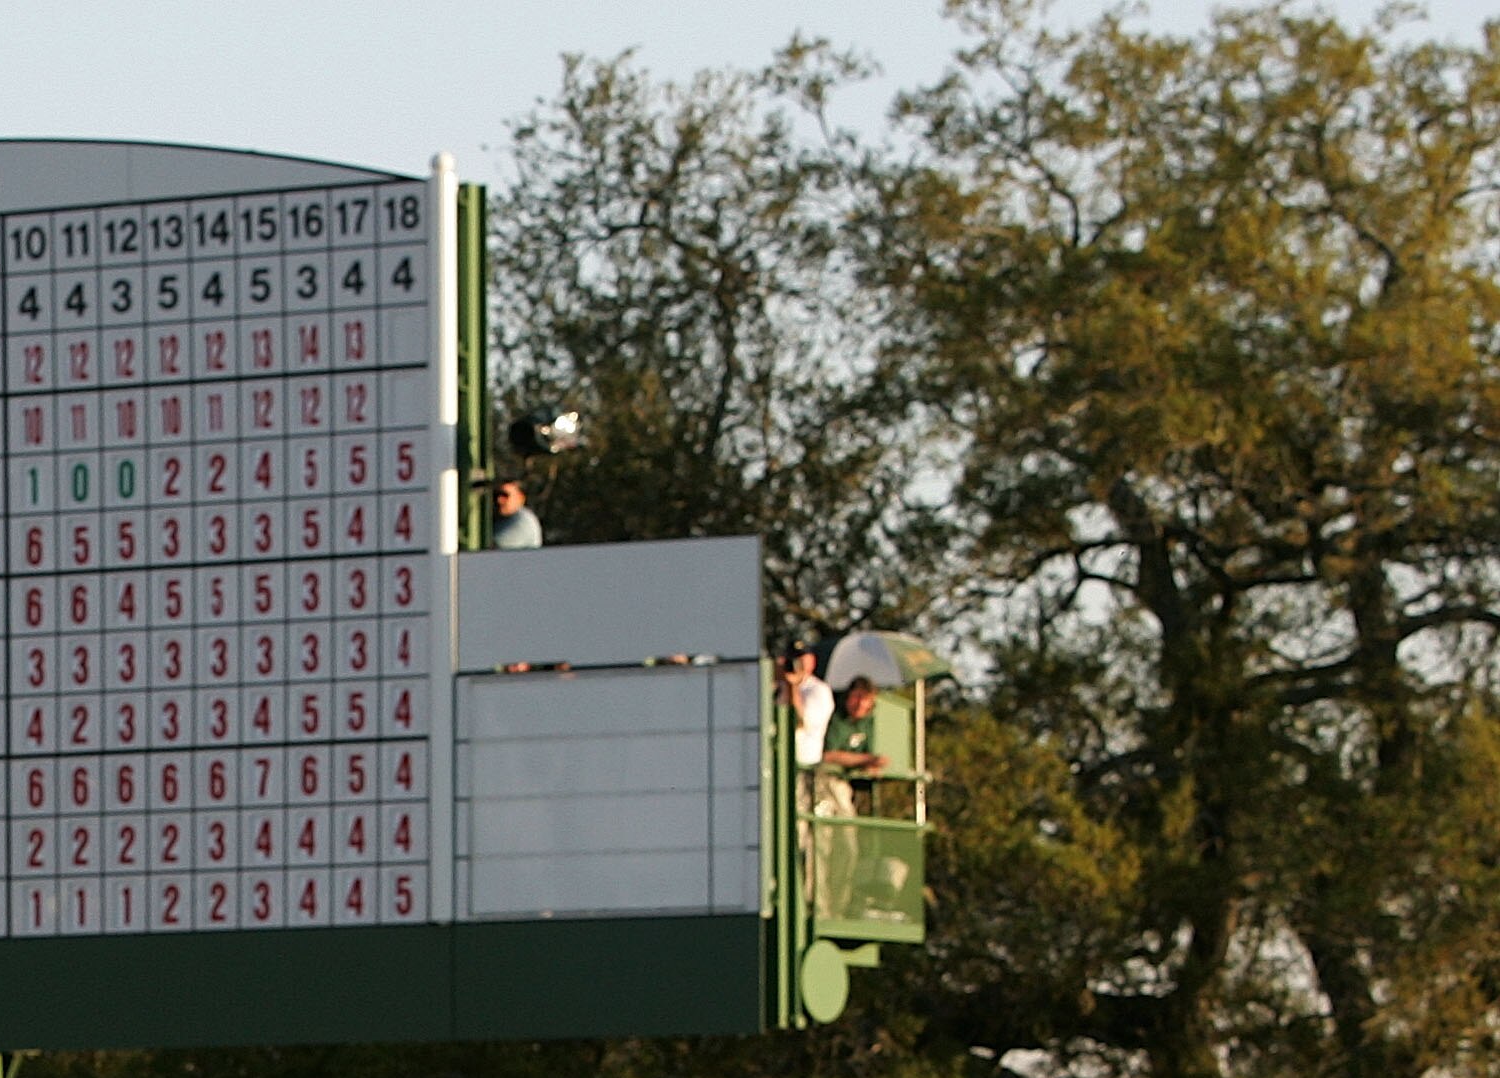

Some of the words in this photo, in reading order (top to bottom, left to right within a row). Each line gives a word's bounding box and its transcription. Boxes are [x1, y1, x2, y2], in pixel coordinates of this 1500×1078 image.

[12, 226, 47, 260] 10
[64, 224, 88, 256] 11
[106, 218, 138, 253] 12
[150, 215, 183, 249] 13
[196, 211, 230, 246] 14
[242, 206, 277, 242] 15
[290, 203, 323, 238] 16
[337, 199, 369, 235] 17
[386, 195, 420, 230] 18
[18, 286, 41, 321] 4
[64, 282, 88, 317] 4
[111, 279, 132, 314] 3
[158, 275, 179, 310] 5
[202, 271, 225, 306] 4
[250, 267, 271, 303] 5
[297, 265, 318, 300] 3
[342, 260, 365, 295] 4
[391, 256, 415, 292] 4
[25, 526, 43, 567] 6
[73, 525, 90, 565] 5
[118, 520, 136, 561] 5
[163, 517, 180, 558] 3
[209, 514, 227, 555] 3
[255, 512, 272, 553] 3
[303, 508, 320, 549] 5
[347, 505, 365, 545] 4
[394, 503, 413, 542] 4
[25, 587, 43, 628] 6
[70, 585, 88, 625] 6
[118, 582, 136, 621] 4
[165, 579, 183, 619] 5
[211, 577, 224, 617] 5
[254, 573, 273, 614] 5
[302, 571, 320, 613] 3
[349, 569, 367, 610] 3
[395, 565, 414, 608] 3
[26, 707, 45, 746] 4
[70, 704, 89, 745] 2
[118, 703, 136, 744] 3
[162, 700, 180, 741] 3
[211, 698, 228, 740] 3
[252, 696, 272, 735] 4
[301, 694, 320, 735] 5
[347, 691, 366, 732] 5
[393, 688, 413, 729] 4
[27, 768, 45, 809] 6
[71, 766, 89, 807] 6
[116, 764, 135, 805] 6
[161, 763, 179, 803] 6
[208, 760, 226, 801] 6
[254, 757, 271, 798] 7
[300, 755, 319, 796] 6
[348, 753, 366, 795] 5
[395, 752, 413, 791] 4
[253, 880, 271, 921] 3
[298, 878, 318, 916] 4
[345, 877, 364, 915] 4
[395, 874, 413, 915] 5
